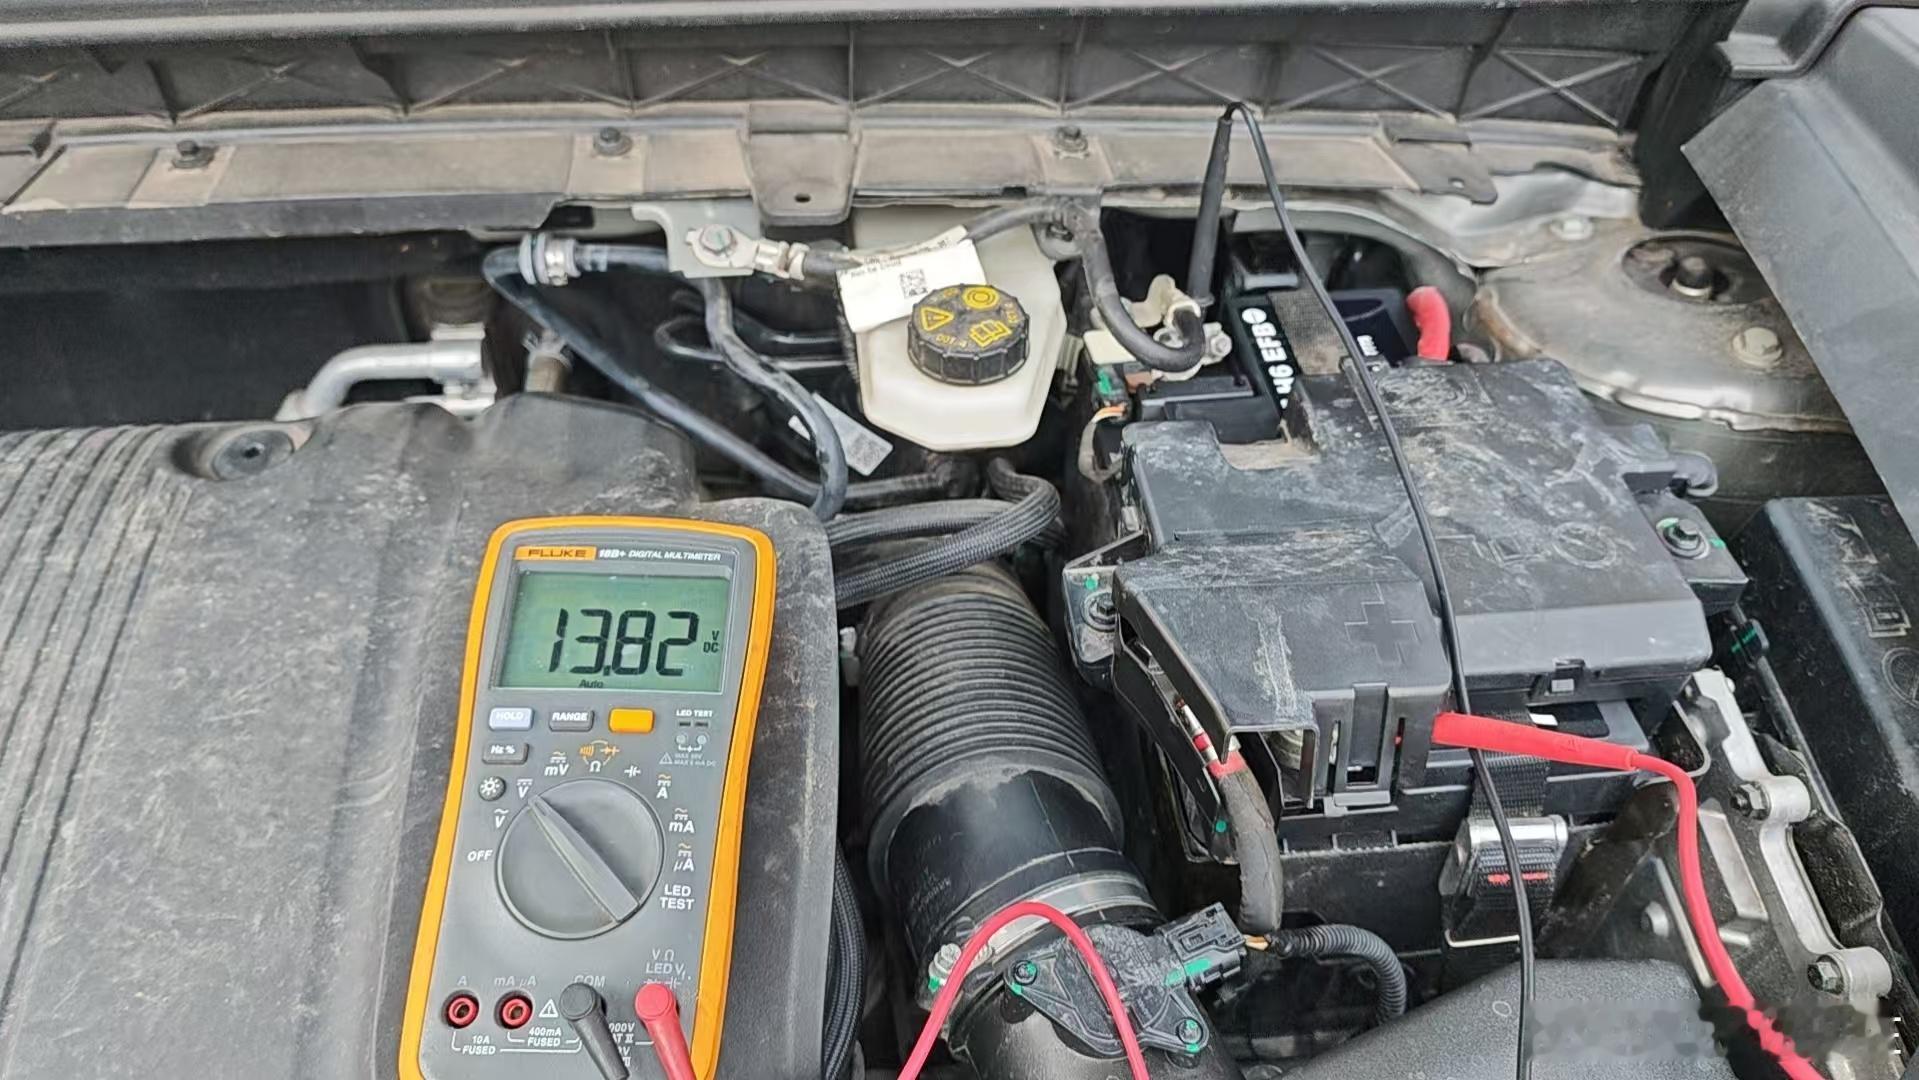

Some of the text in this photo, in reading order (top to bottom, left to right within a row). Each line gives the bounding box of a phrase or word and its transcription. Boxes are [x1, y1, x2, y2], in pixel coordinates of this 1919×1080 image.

[1250, 320, 1288, 362] EFB
[528, 549, 587, 558] FLUKE
[628, 550, 662, 559] DIGITAL
[664, 552, 721, 561] MULTIMETER
[712, 631, 720, 640] V
[548, 608, 699, 677] 13.82
[703, 641, 720, 653] DC
[578, 679, 604, 689] Auto
[495, 711, 525, 721] HOLD
[552, 711, 588, 722] RANGE
[676, 709, 713, 718] LED TEST
[490, 745, 504, 754] Hz
[544, 763, 568, 776] mV
[656, 787, 669, 799] A
[669, 821, 695, 833] mA
[467, 849, 493, 862] OFF
[664, 884, 691, 897] LED
[660, 898, 695, 910] TEST
[652, 949, 661, 960] V
[646, 962, 671, 974] LED
[457, 976, 468, 986] A
[494, 976, 516, 986] mA
[574, 975, 605, 987] COM
[528, 1028, 562, 1037] 400mA
[472, 1036, 490, 1045] 10A
[527, 1037, 561, 1047] FUSED
[462, 1045, 496, 1056] FUSED
